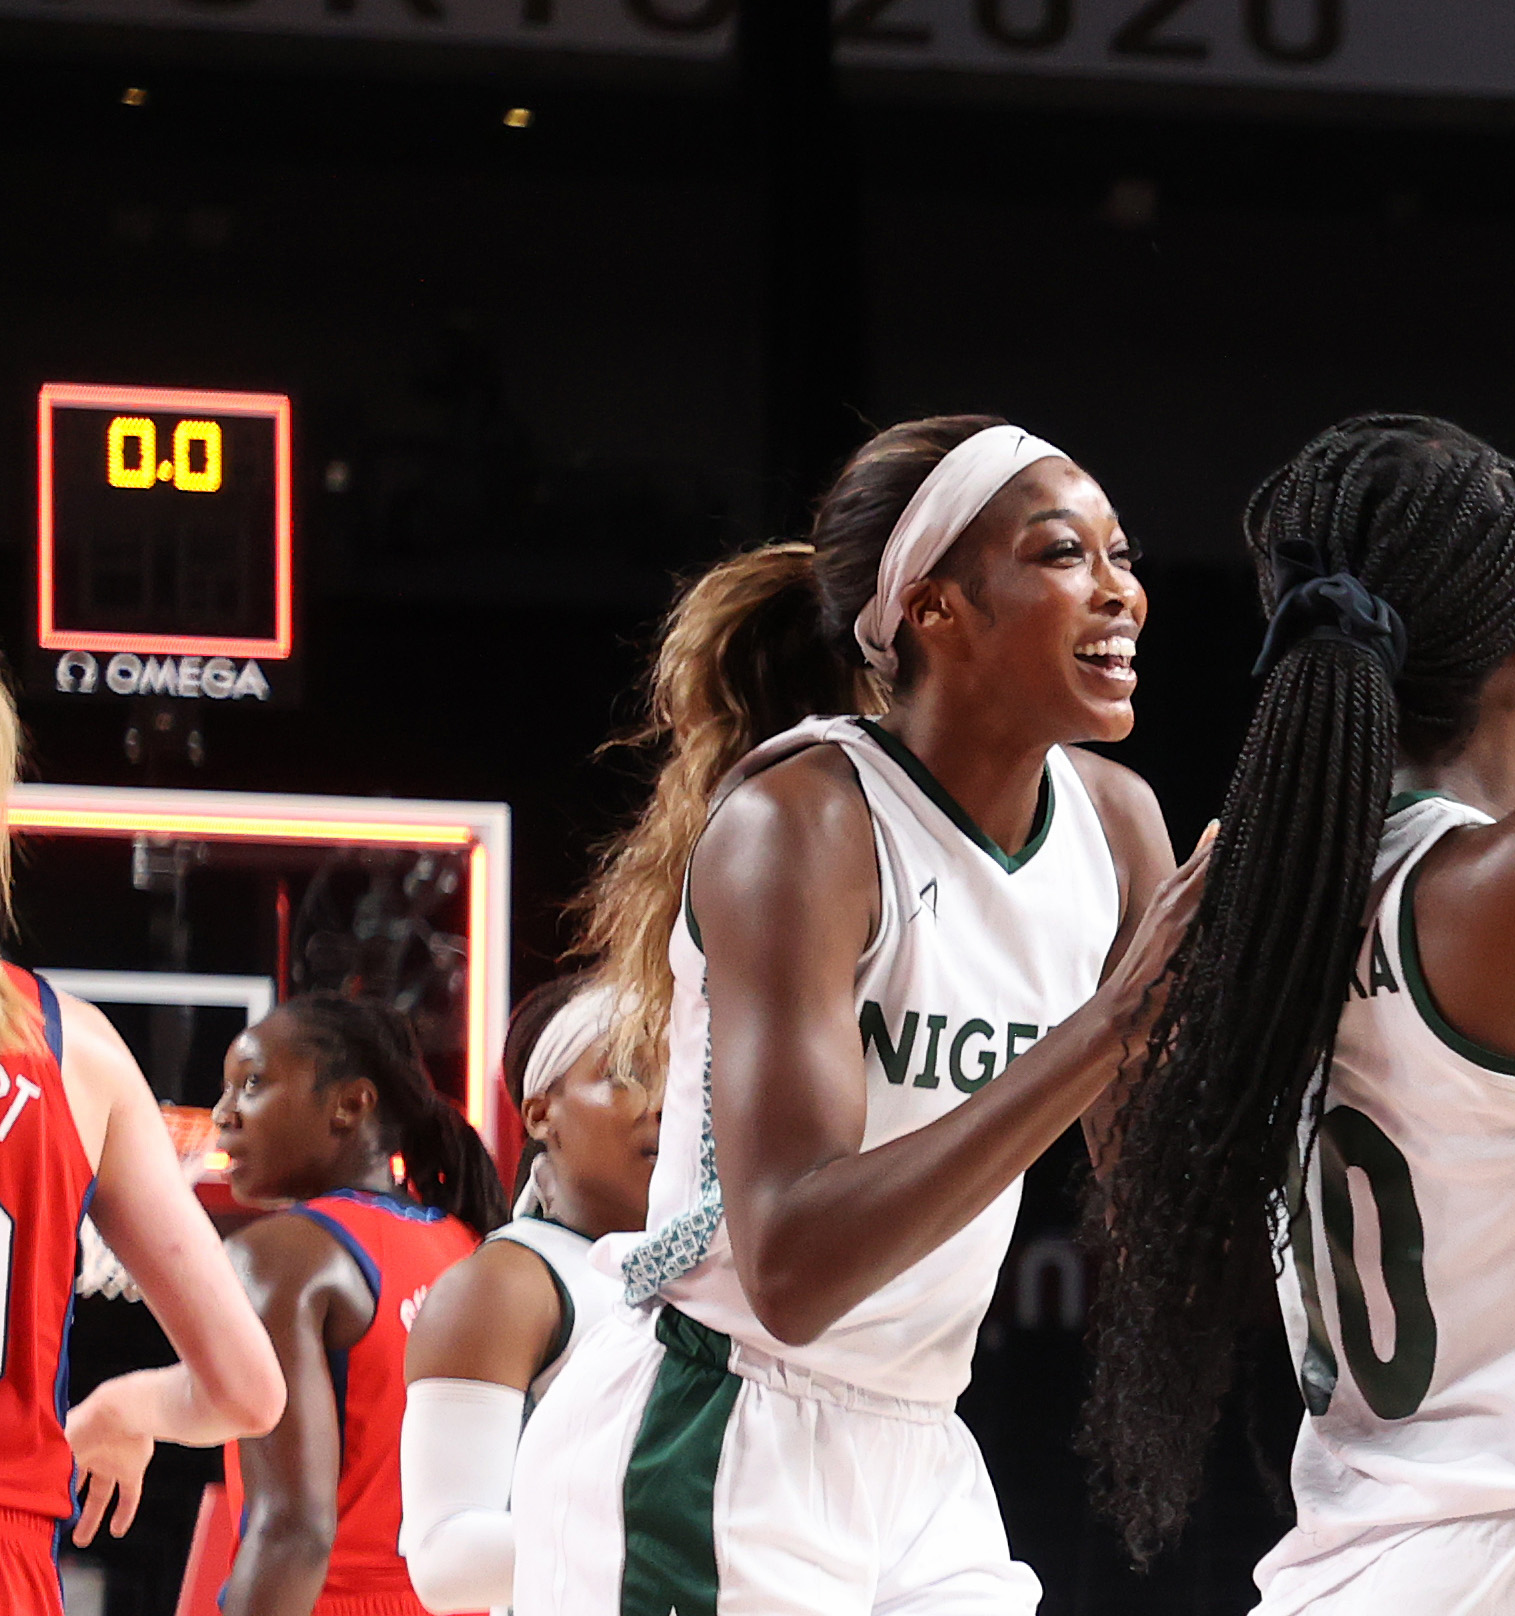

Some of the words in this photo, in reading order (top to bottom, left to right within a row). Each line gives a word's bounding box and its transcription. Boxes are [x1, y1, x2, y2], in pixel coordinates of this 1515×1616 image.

[106, 416, 223, 492] 0.0
[105, 652, 271, 700] OMEGA
[859, 1000, 1062, 1093] NIGE
